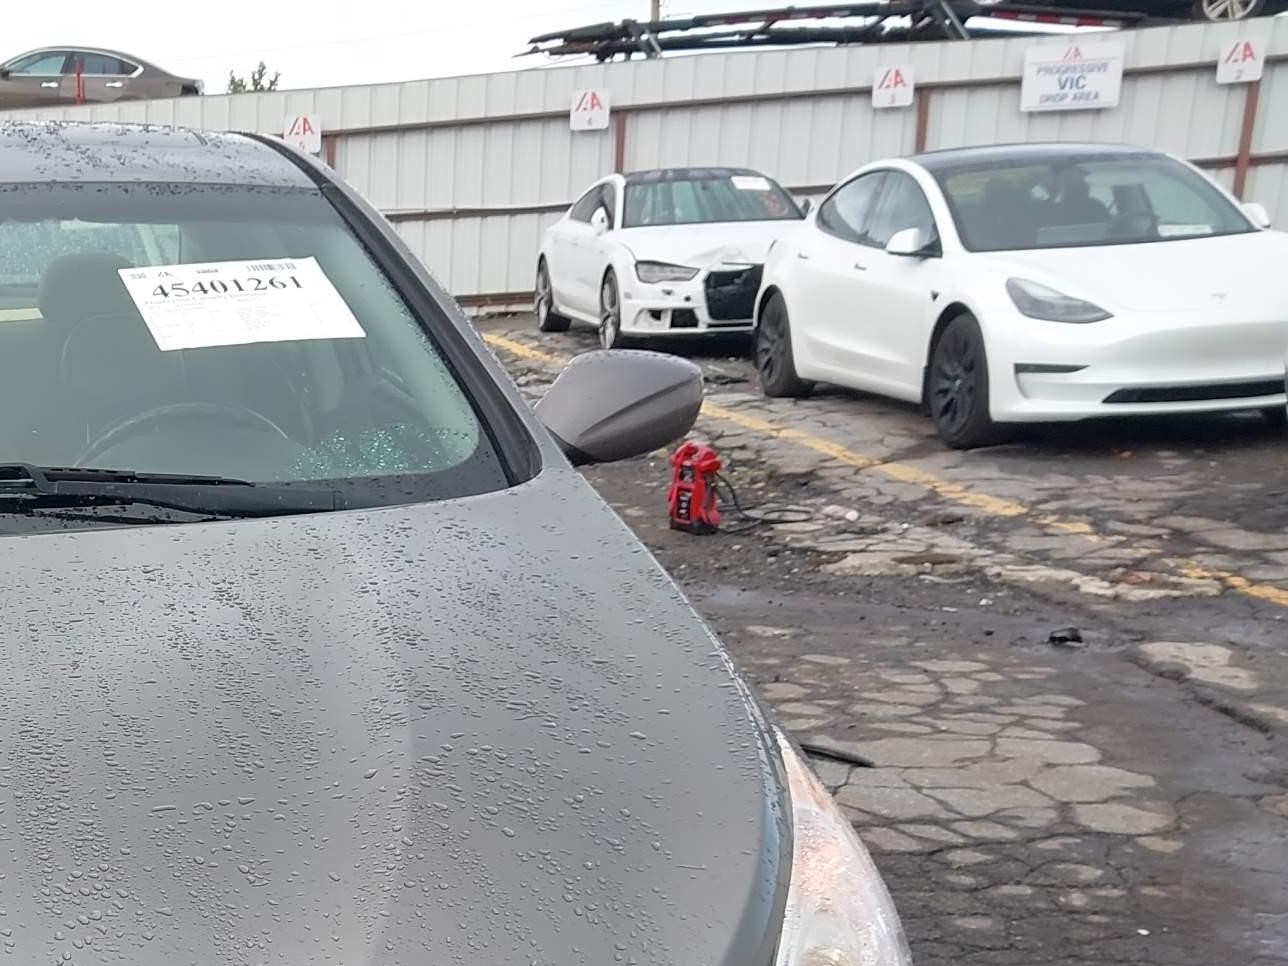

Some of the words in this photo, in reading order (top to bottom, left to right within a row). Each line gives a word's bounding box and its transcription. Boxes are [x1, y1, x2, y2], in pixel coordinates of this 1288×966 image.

[1037, 62, 1109, 76] PROGRESSIVE
[1057, 75, 1087, 90] VIC
[1040, 93, 1069, 104] DROP
[1072, 91, 1100, 102] AREA
[152, 276, 304, 298] 45401261
